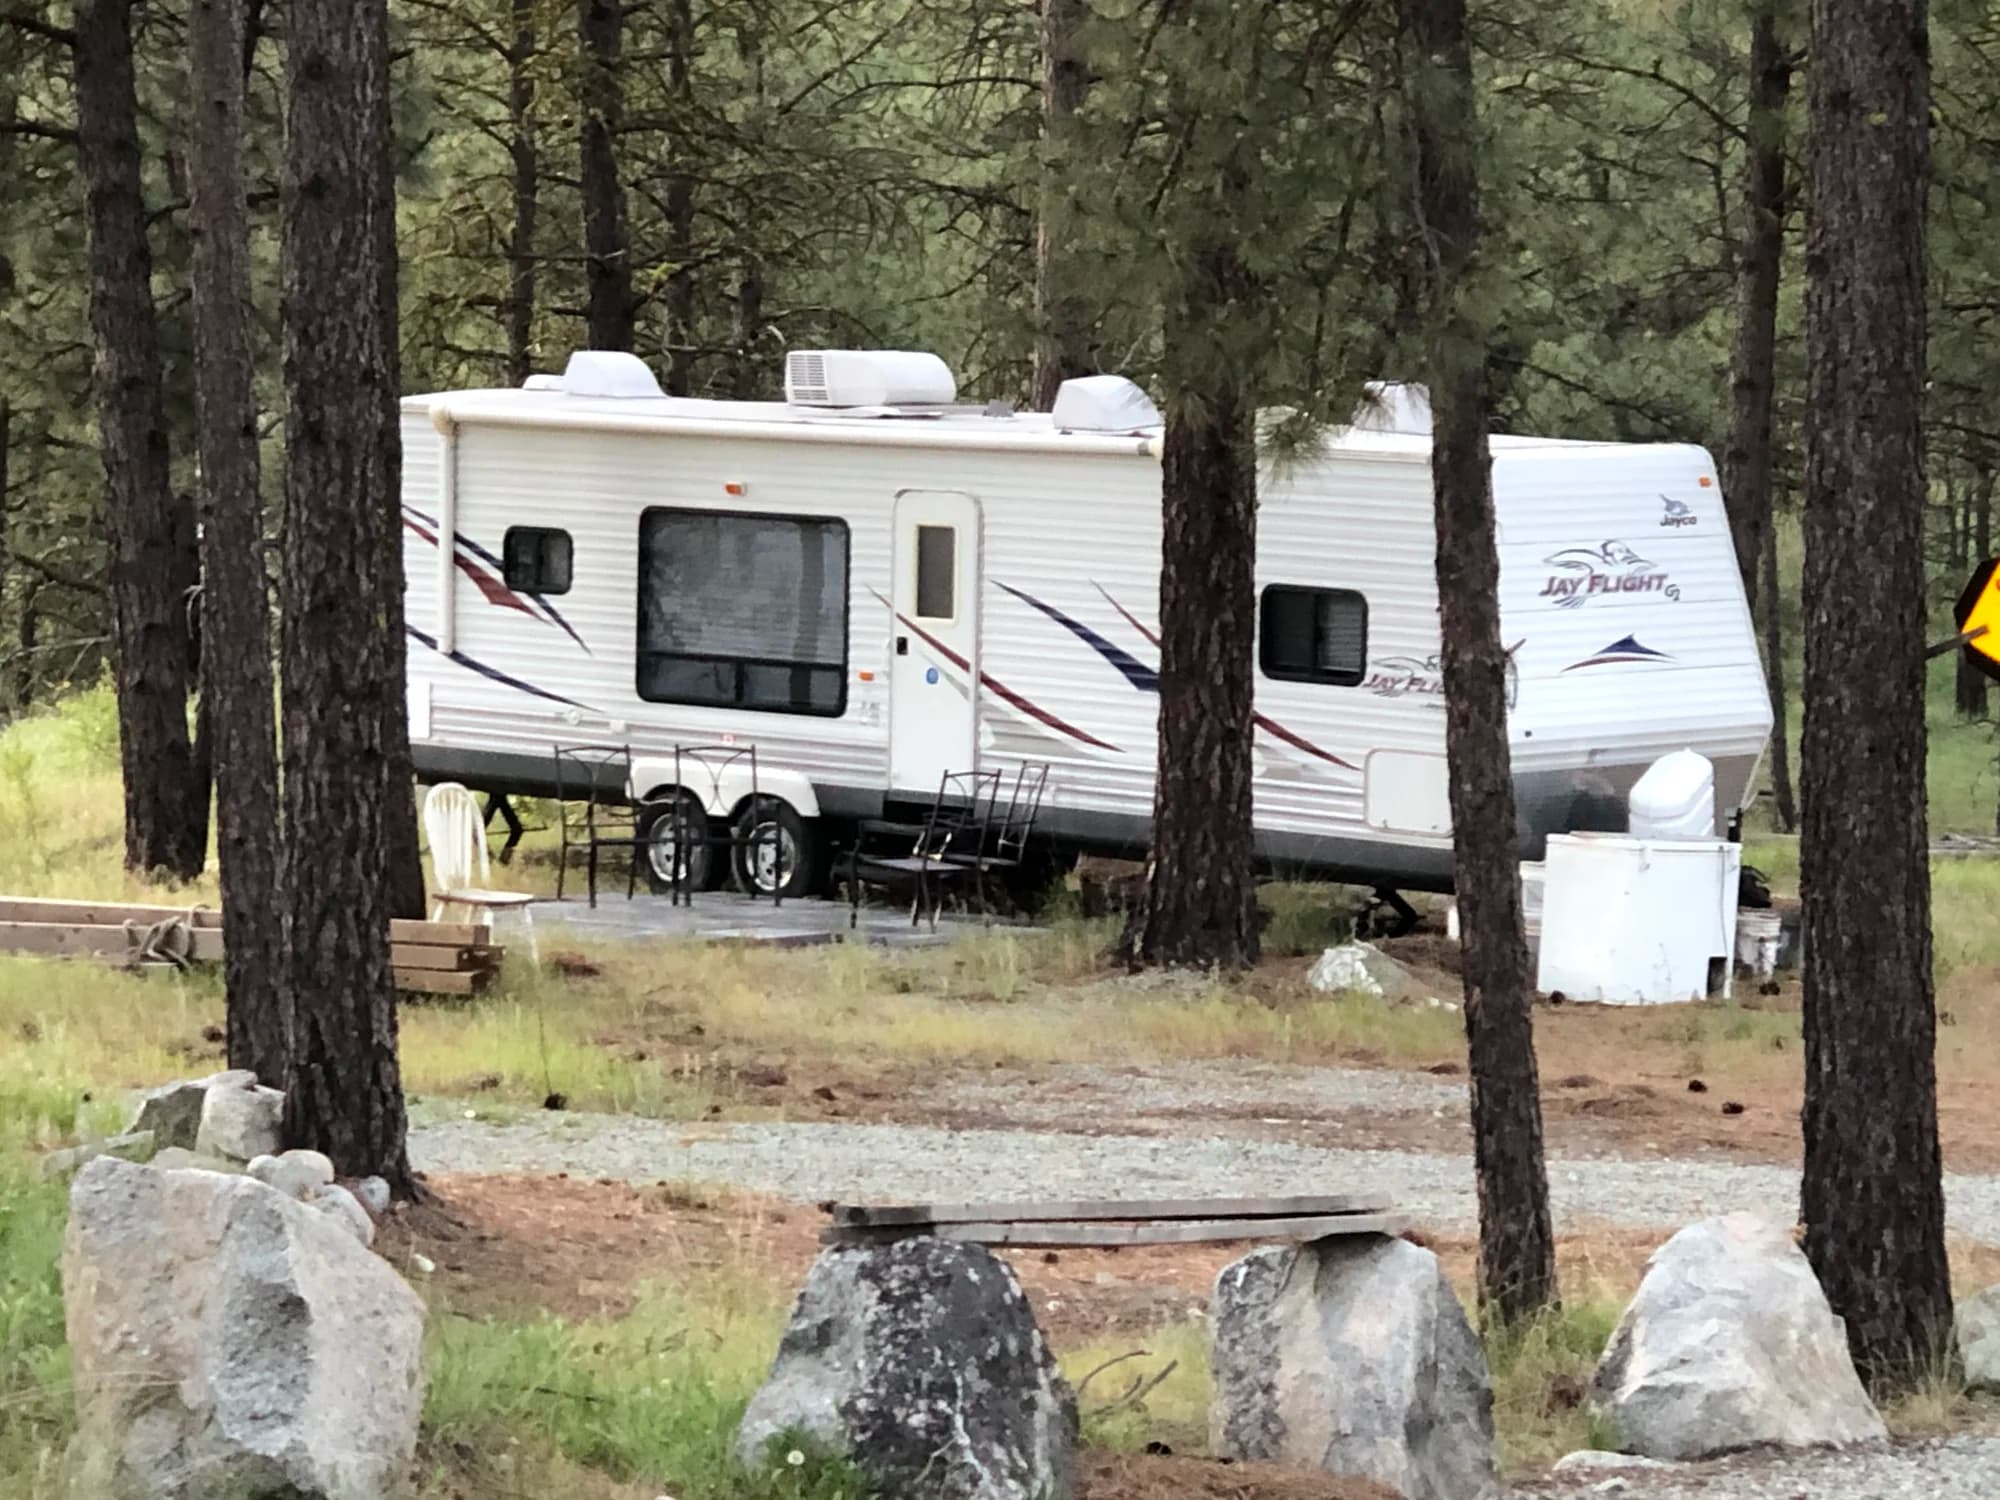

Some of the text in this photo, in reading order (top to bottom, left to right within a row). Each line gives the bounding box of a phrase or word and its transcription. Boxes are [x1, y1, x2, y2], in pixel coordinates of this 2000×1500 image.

[1660, 514, 1697, 528] Jayco
[1539, 576, 1585, 596] JAY
[1587, 574, 1669, 592] FLIGHT
[1362, 674, 1405, 692] JAY
